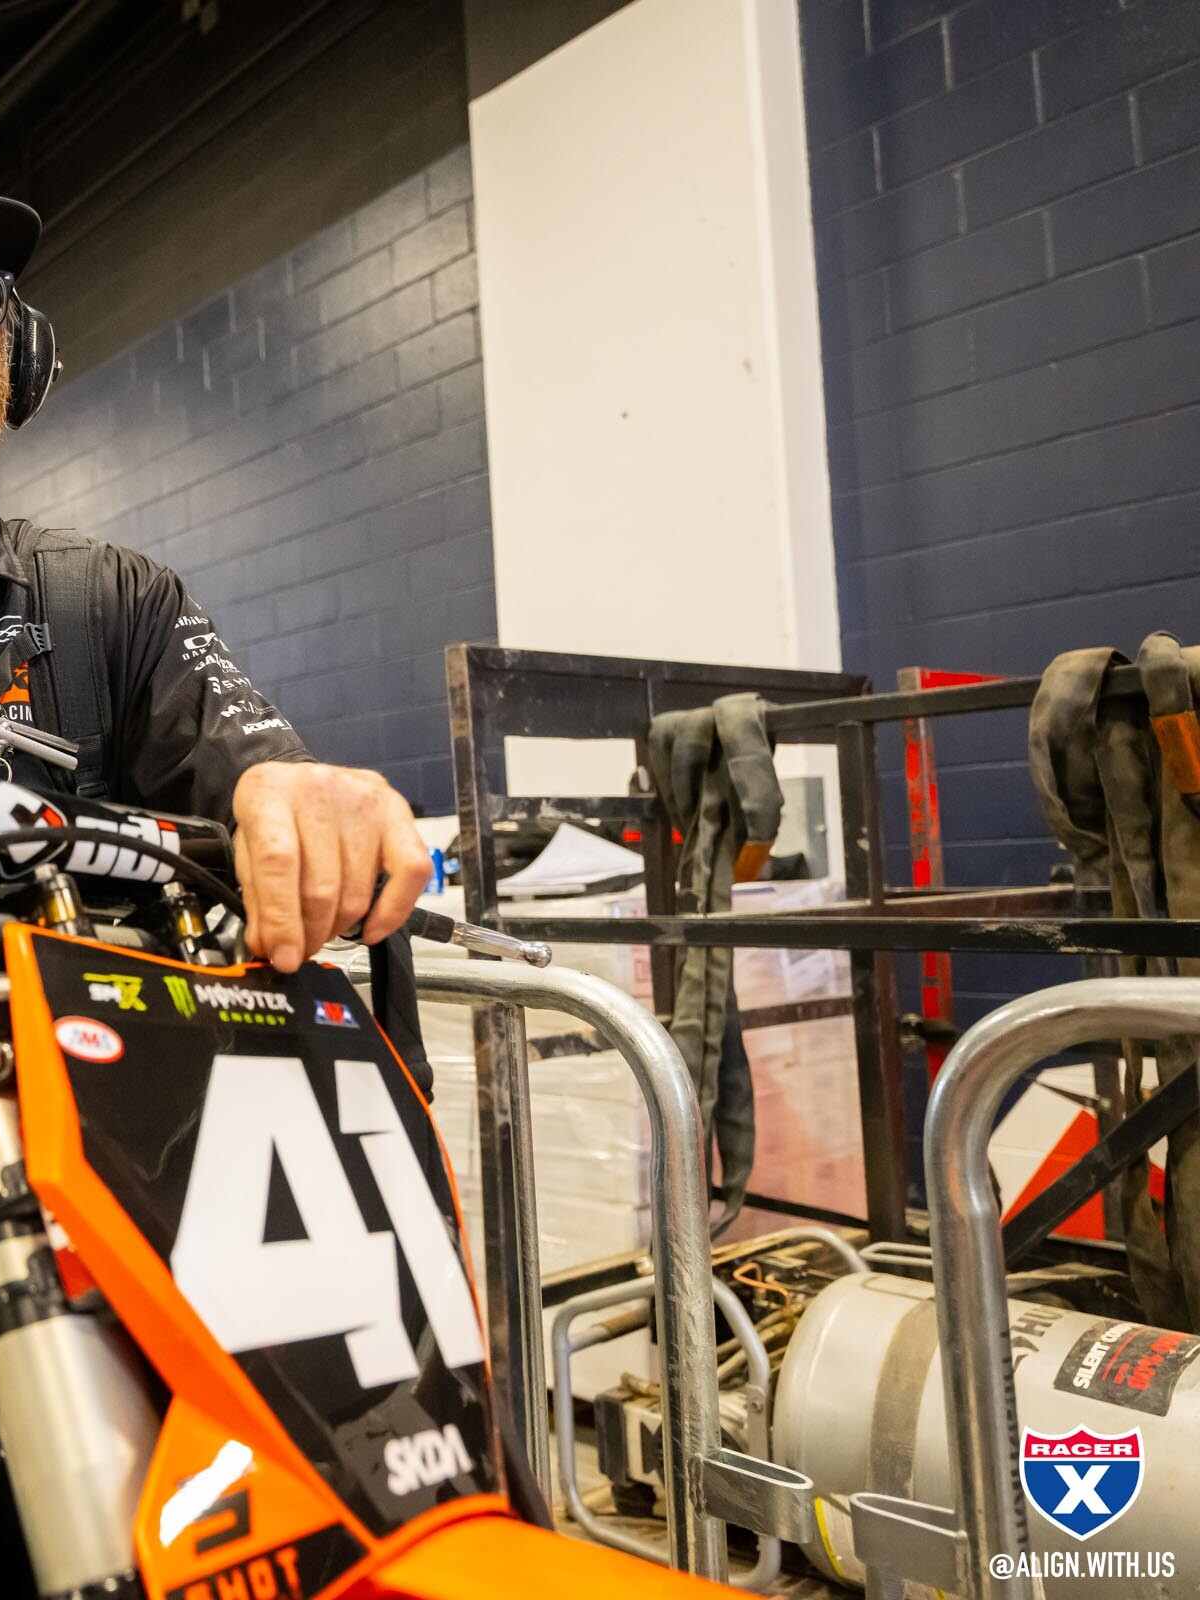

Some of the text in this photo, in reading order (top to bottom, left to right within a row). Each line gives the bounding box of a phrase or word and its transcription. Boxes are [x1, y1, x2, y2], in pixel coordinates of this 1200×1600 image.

[194, 983, 295, 1014] MONSTER
[172, 1055, 485, 1388] 41
[1072, 1341, 1112, 1390] SILENT
